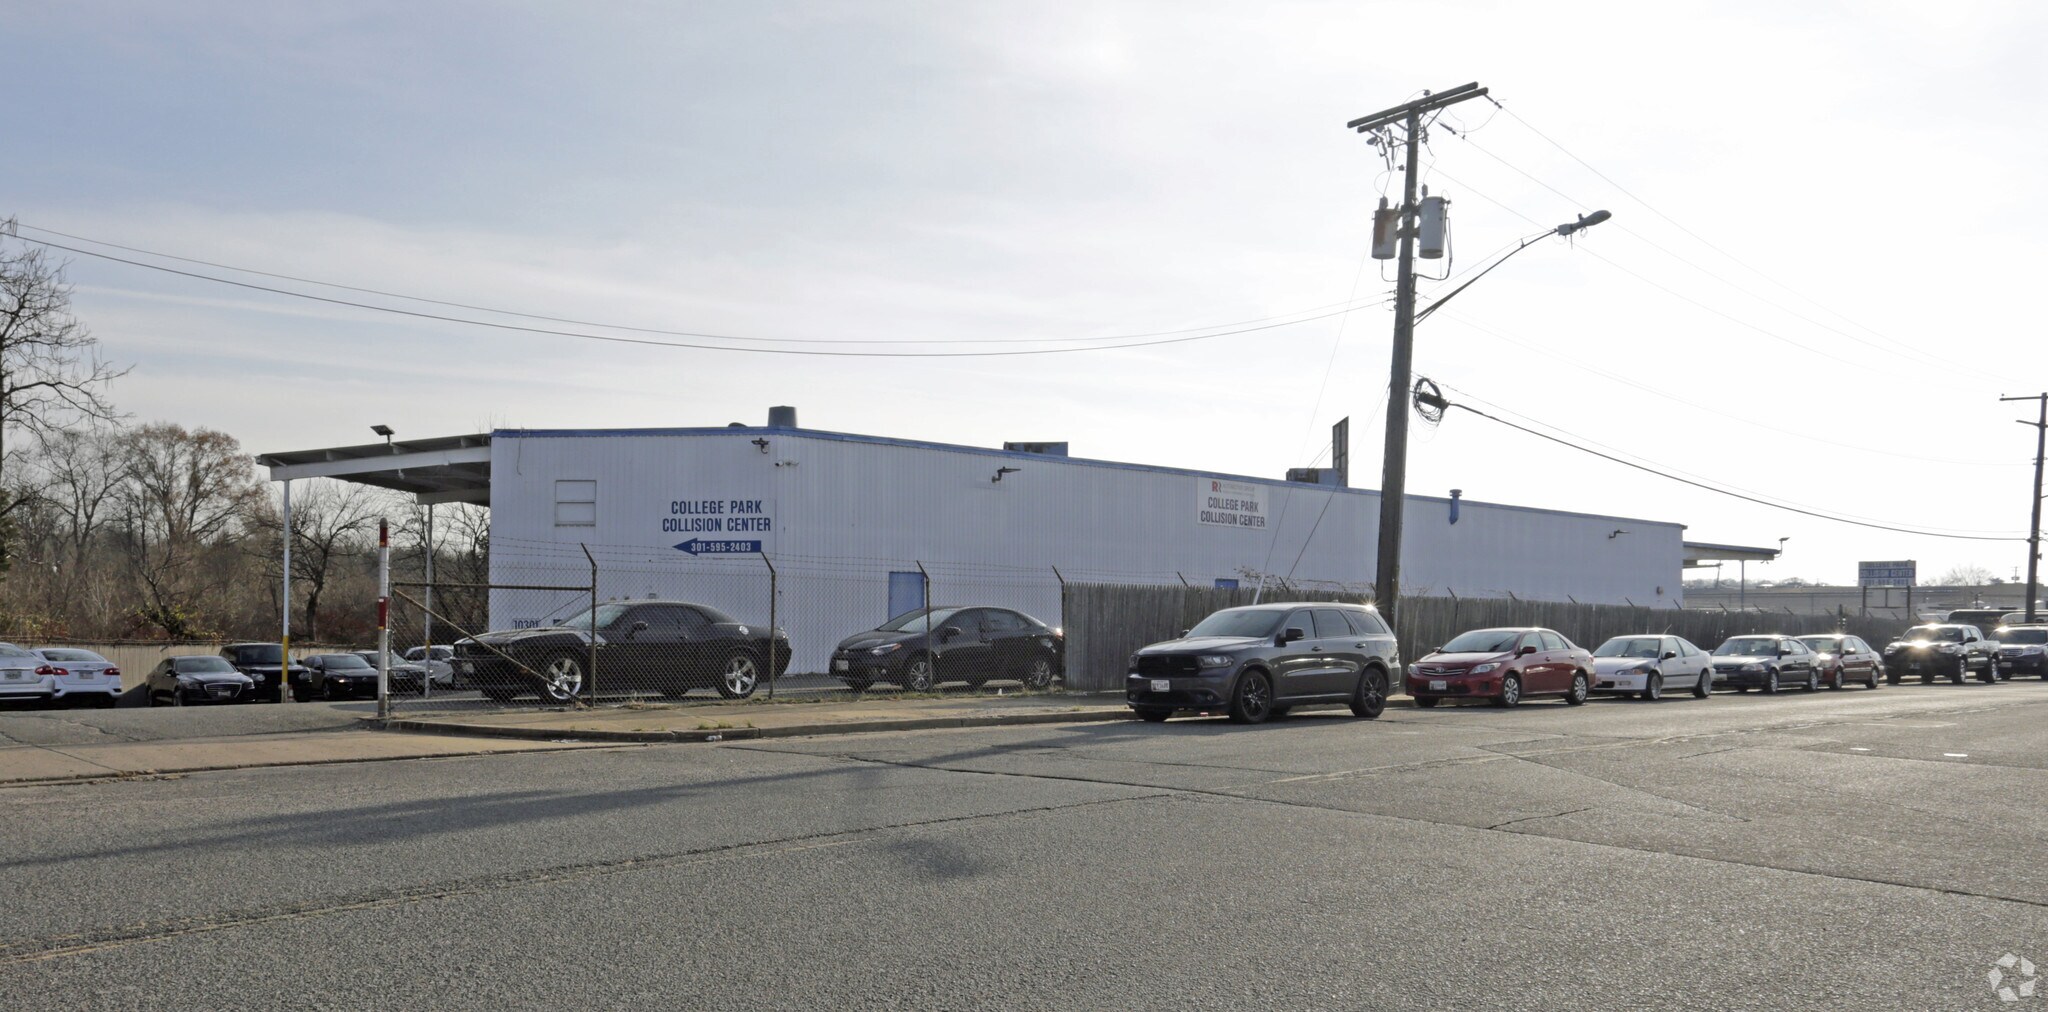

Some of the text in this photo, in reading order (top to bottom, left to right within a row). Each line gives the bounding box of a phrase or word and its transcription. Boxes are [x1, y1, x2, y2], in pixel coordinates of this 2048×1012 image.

[671, 500, 762, 514] COLLEGE PARK
[1208, 496, 1259, 513] COLLEGE PARK
[662, 517, 771, 532] COLLISION CENTER
[1200, 510, 1265, 527] COLLISION CENTER
[691, 542, 752, 552] 301-595-2403
